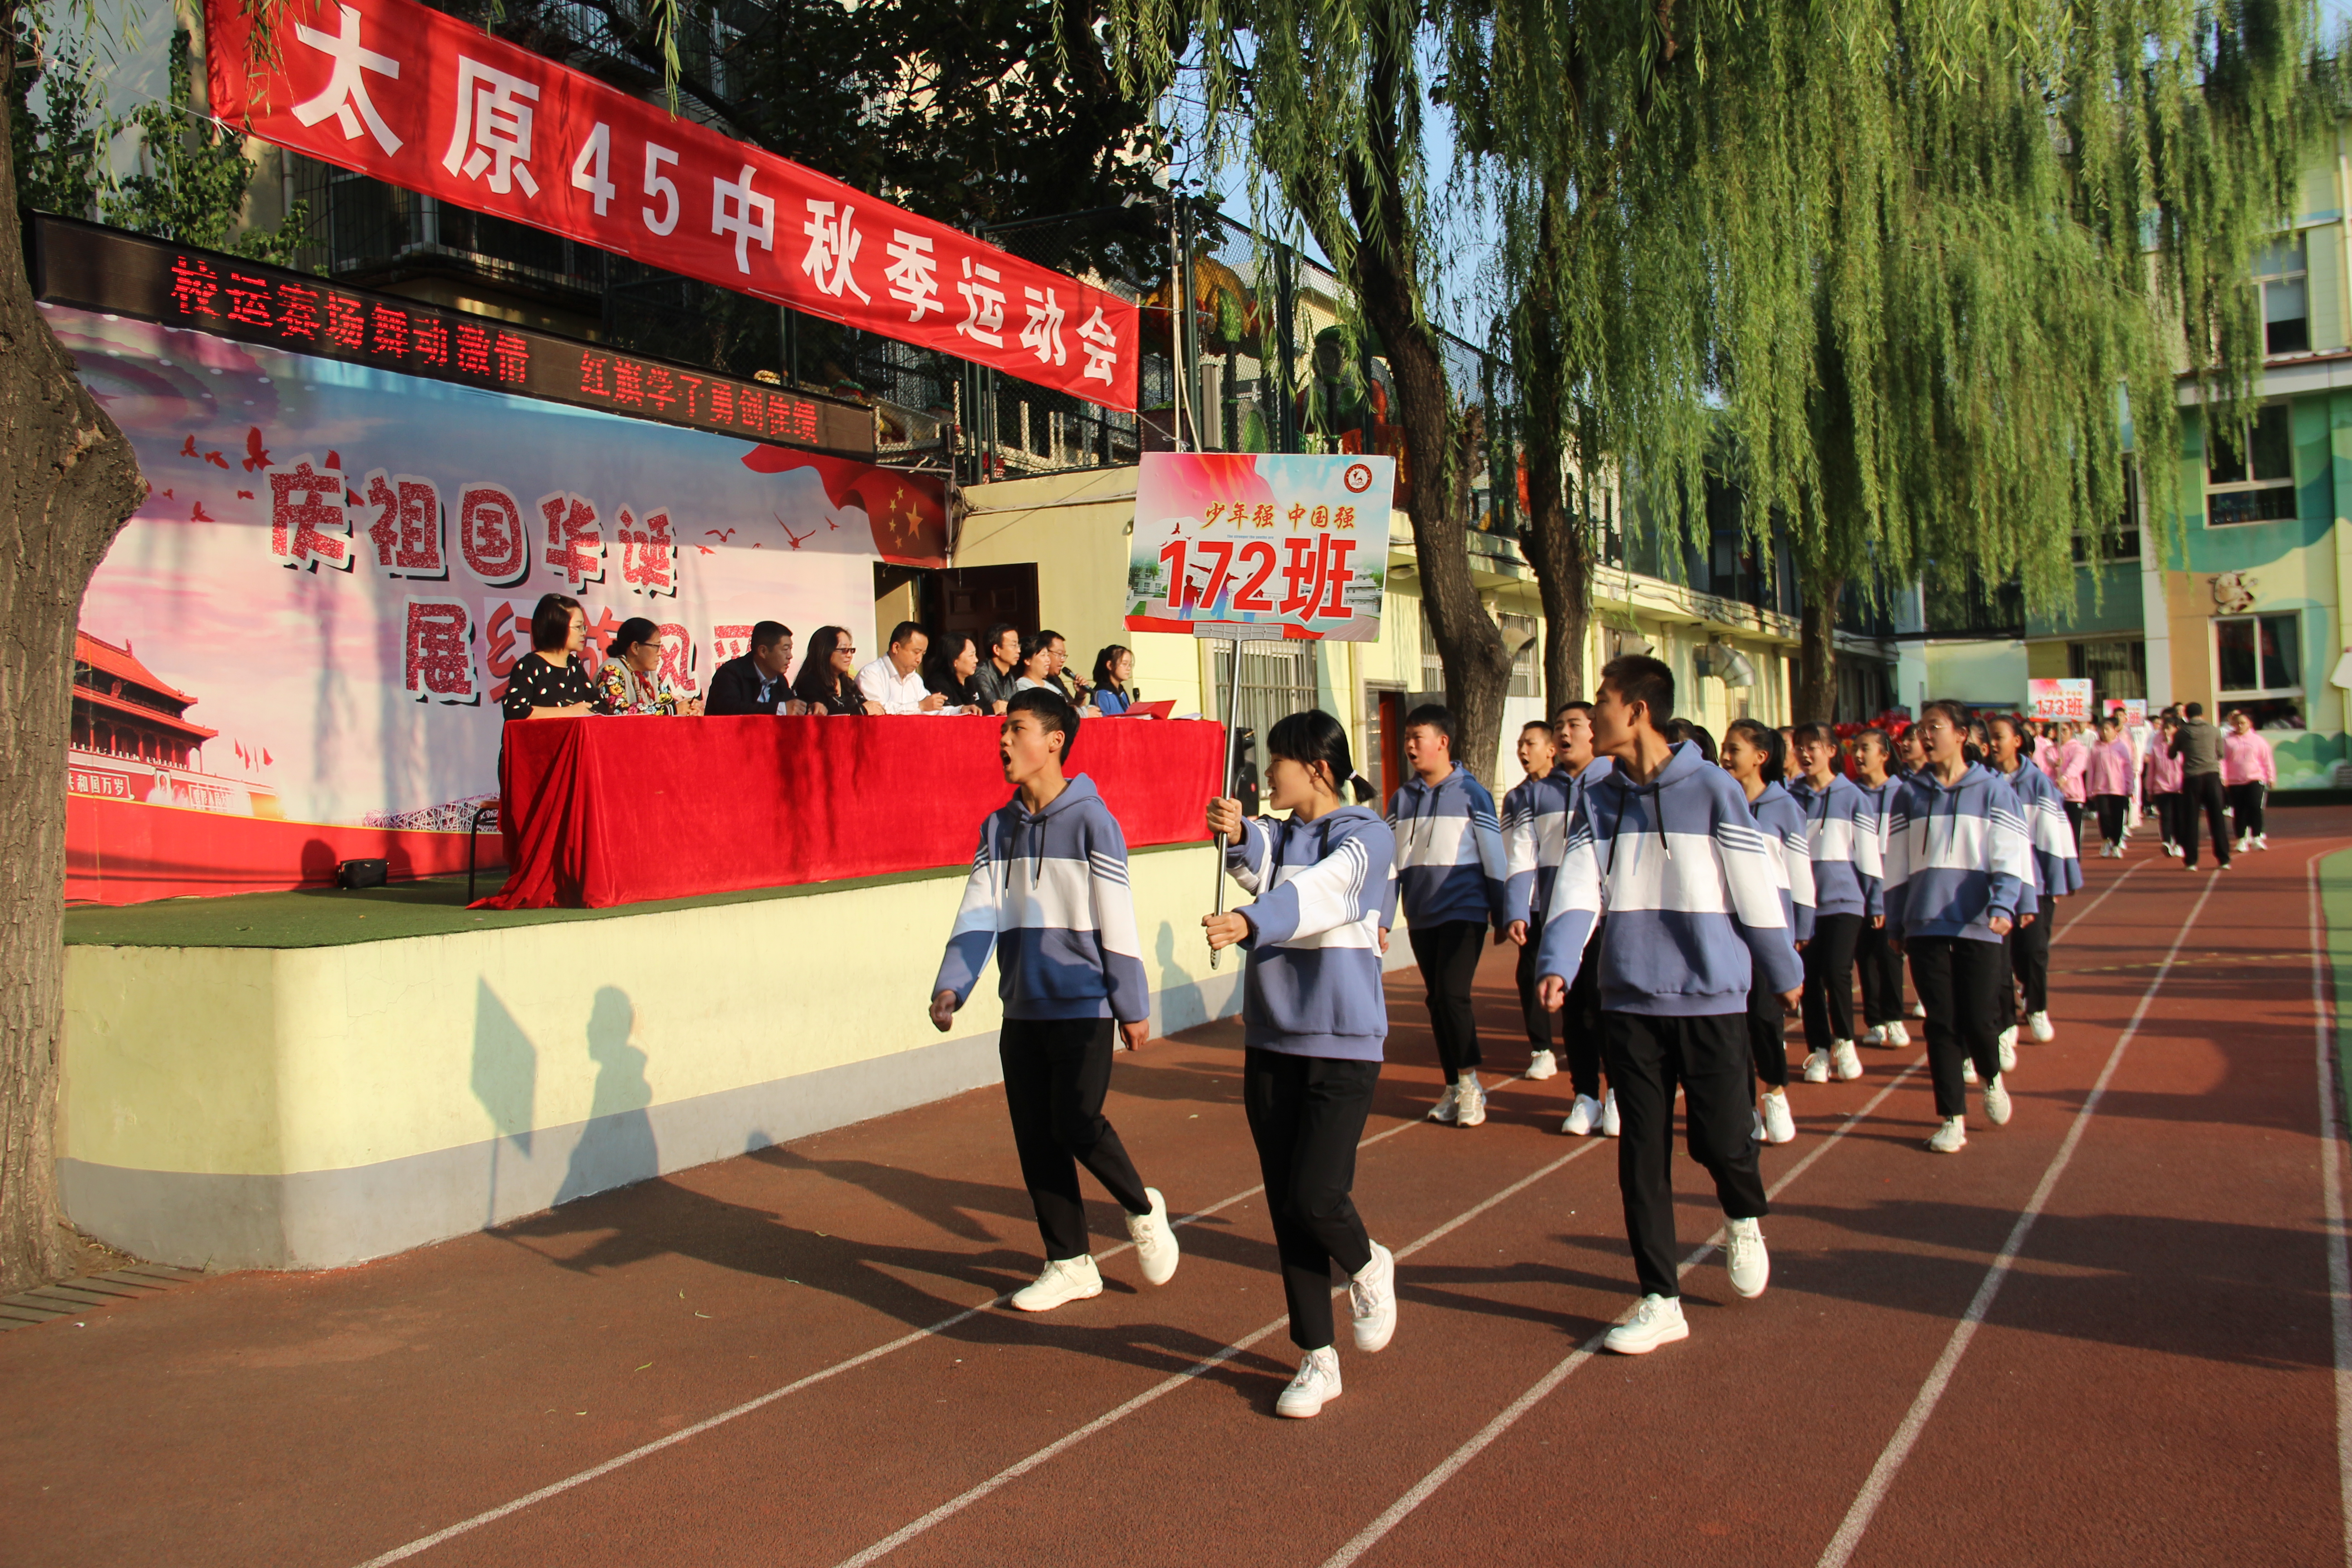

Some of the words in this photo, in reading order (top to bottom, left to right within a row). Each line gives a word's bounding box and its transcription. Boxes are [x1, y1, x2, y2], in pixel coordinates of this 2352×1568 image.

[290, 3, 1118, 387] 太原45中秋季运动会
[171, 255, 530, 383] 校运赛场舞动激情
[269, 461, 672, 588] 庆祖国华诞
[1200, 502, 1274, 530] 少年强
[1288, 503, 1355, 531] 中国强
[1158, 533, 1357, 624] 172班
[2035, 697, 2083, 716] 173班
